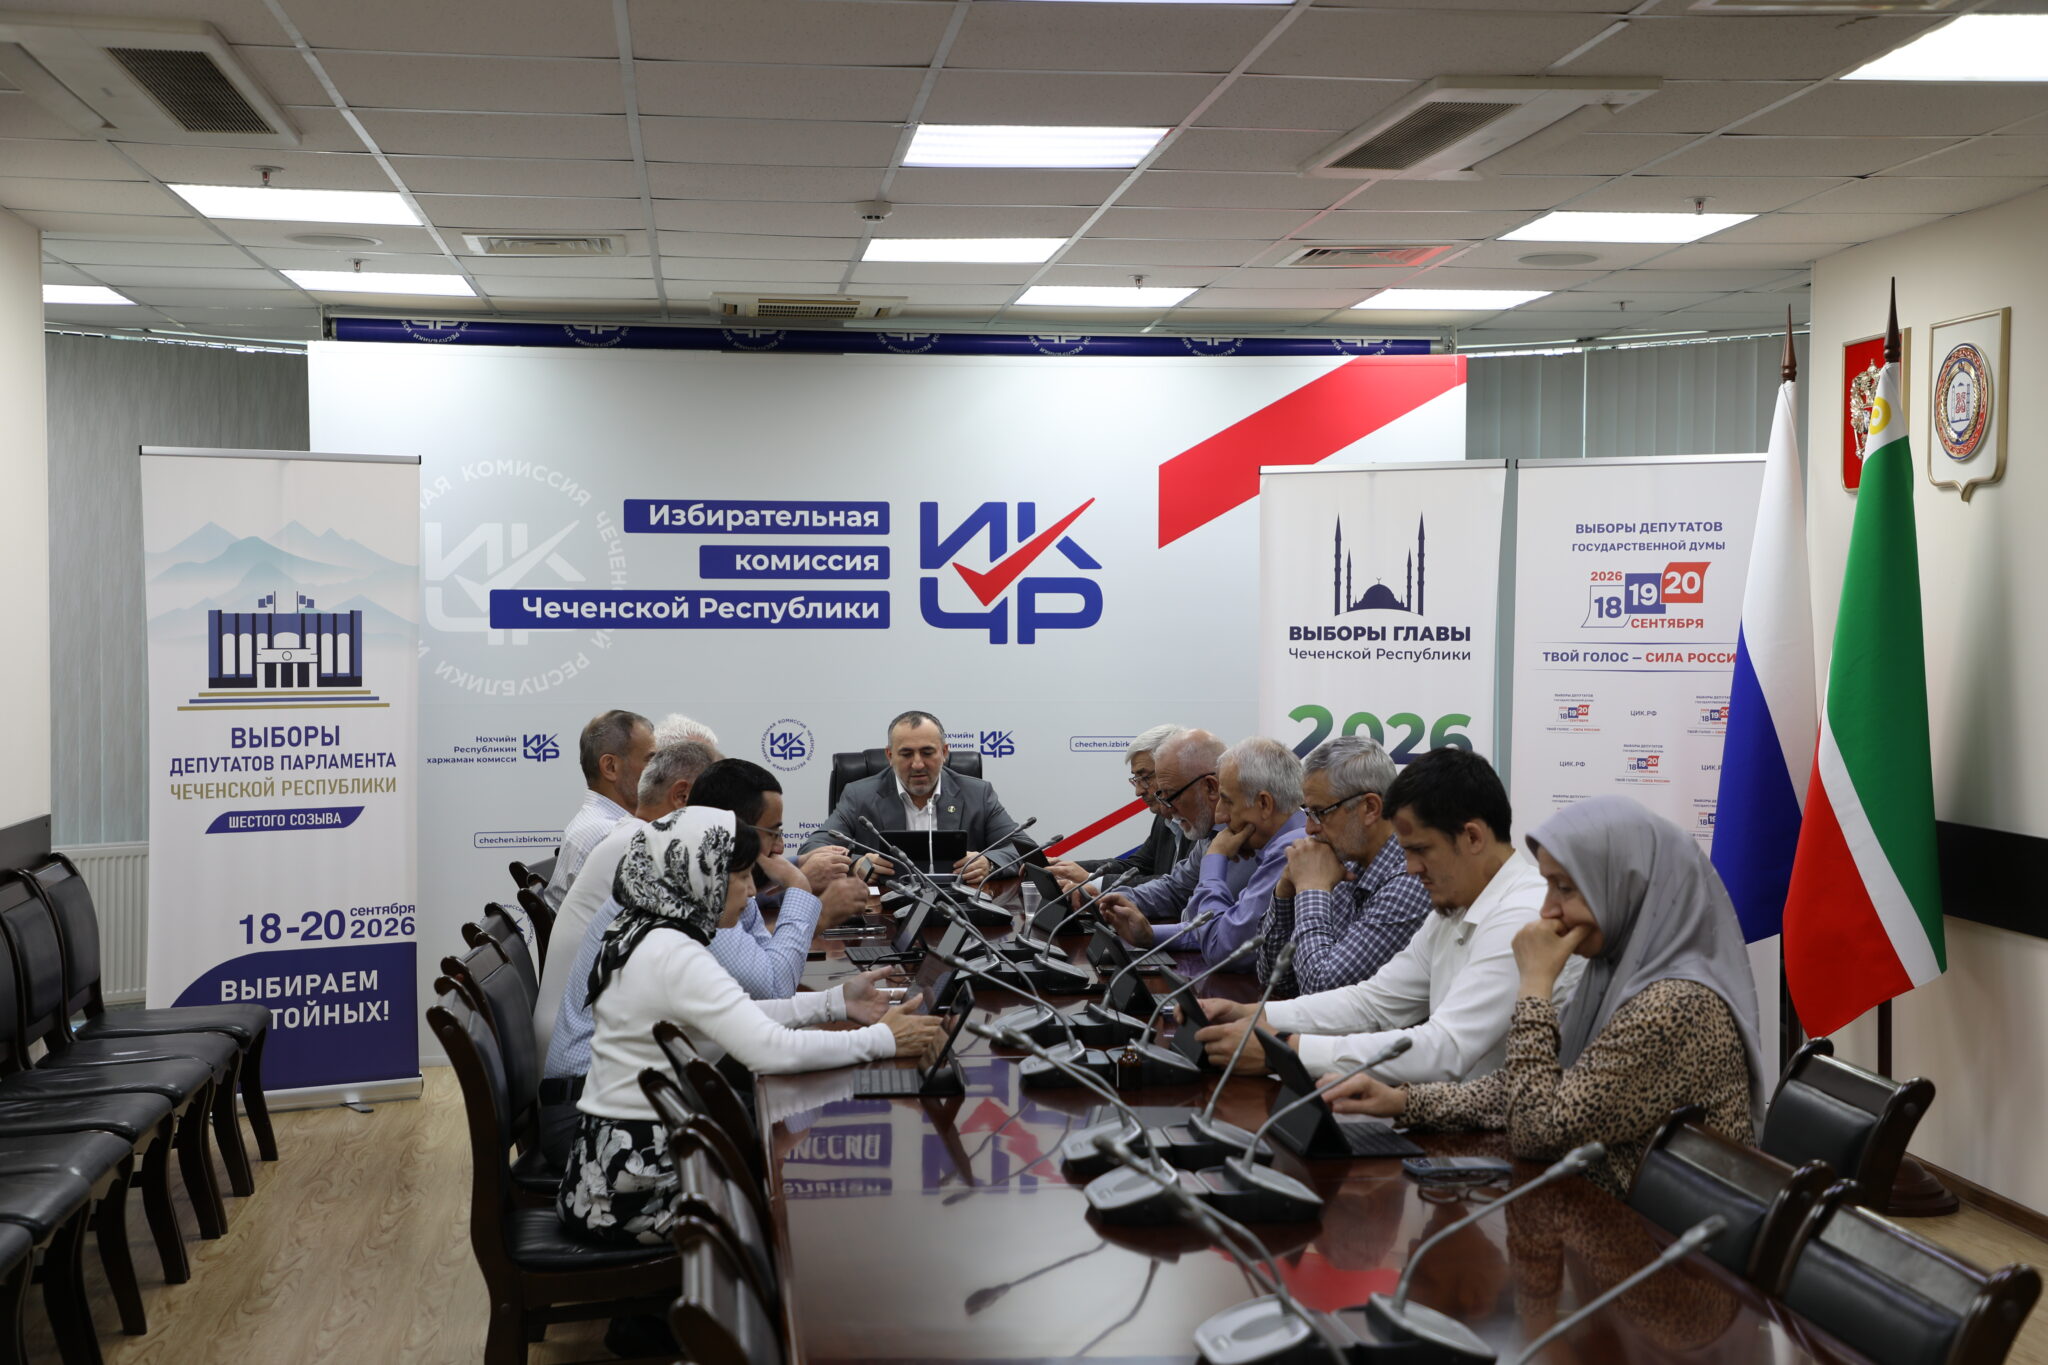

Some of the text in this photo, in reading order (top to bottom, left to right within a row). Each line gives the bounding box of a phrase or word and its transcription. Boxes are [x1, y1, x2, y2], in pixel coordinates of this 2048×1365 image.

[461, 459, 592, 507] КОМИССИЯ
[649, 503, 879, 531] Избирательная
[1575, 522, 1723, 534] ВЫБОРЫ ДЕПУТАТОВ
[1572, 540, 1726, 553] ГОСУДАРСТВЕННОЙ ДУМЫ
[735, 554, 879, 571] комиссия
[1590, 571, 1623, 581] 2026
[1594, 571, 1701, 619] 18 19 20
[522, 596, 879, 624] Чеченской Республики
[1631, 618, 1704, 629] СЕНТЯБРЯ
[1289, 625, 1471, 642] ВЫБОРЫ ГЛАВЫ
[1289, 648, 1471, 663] Чеченской Республики
[1543, 650, 1580, 663] ТВОЙ
[1583, 652, 1629, 663] ГОЛОС
[1645, 652, 1684, 663] СИЛА
[434, 651, 591, 696] РЕСПУБЛИКИ
[231, 725, 340, 749] ВЫБОРЫ
[476, 735, 517, 743] Нохчийн
[453, 745, 517, 754] Республикин
[170, 752, 397, 777] ДЕПУТАТОВ ПАРЛАМЕНТА
[170, 777, 397, 800] ЧЕЧЕНСКОЙ РЕСПУБЛИКИ
[228, 811, 342, 829] ШЕСТОГО СОЗЫВА
[479, 835, 562, 844] chechen.izbirkom.ru
[350, 902, 416, 917] сентября
[239, 909, 416, 945] 18-20 2026
[221, 969, 378, 1002] ВЫБИРАЕМ
